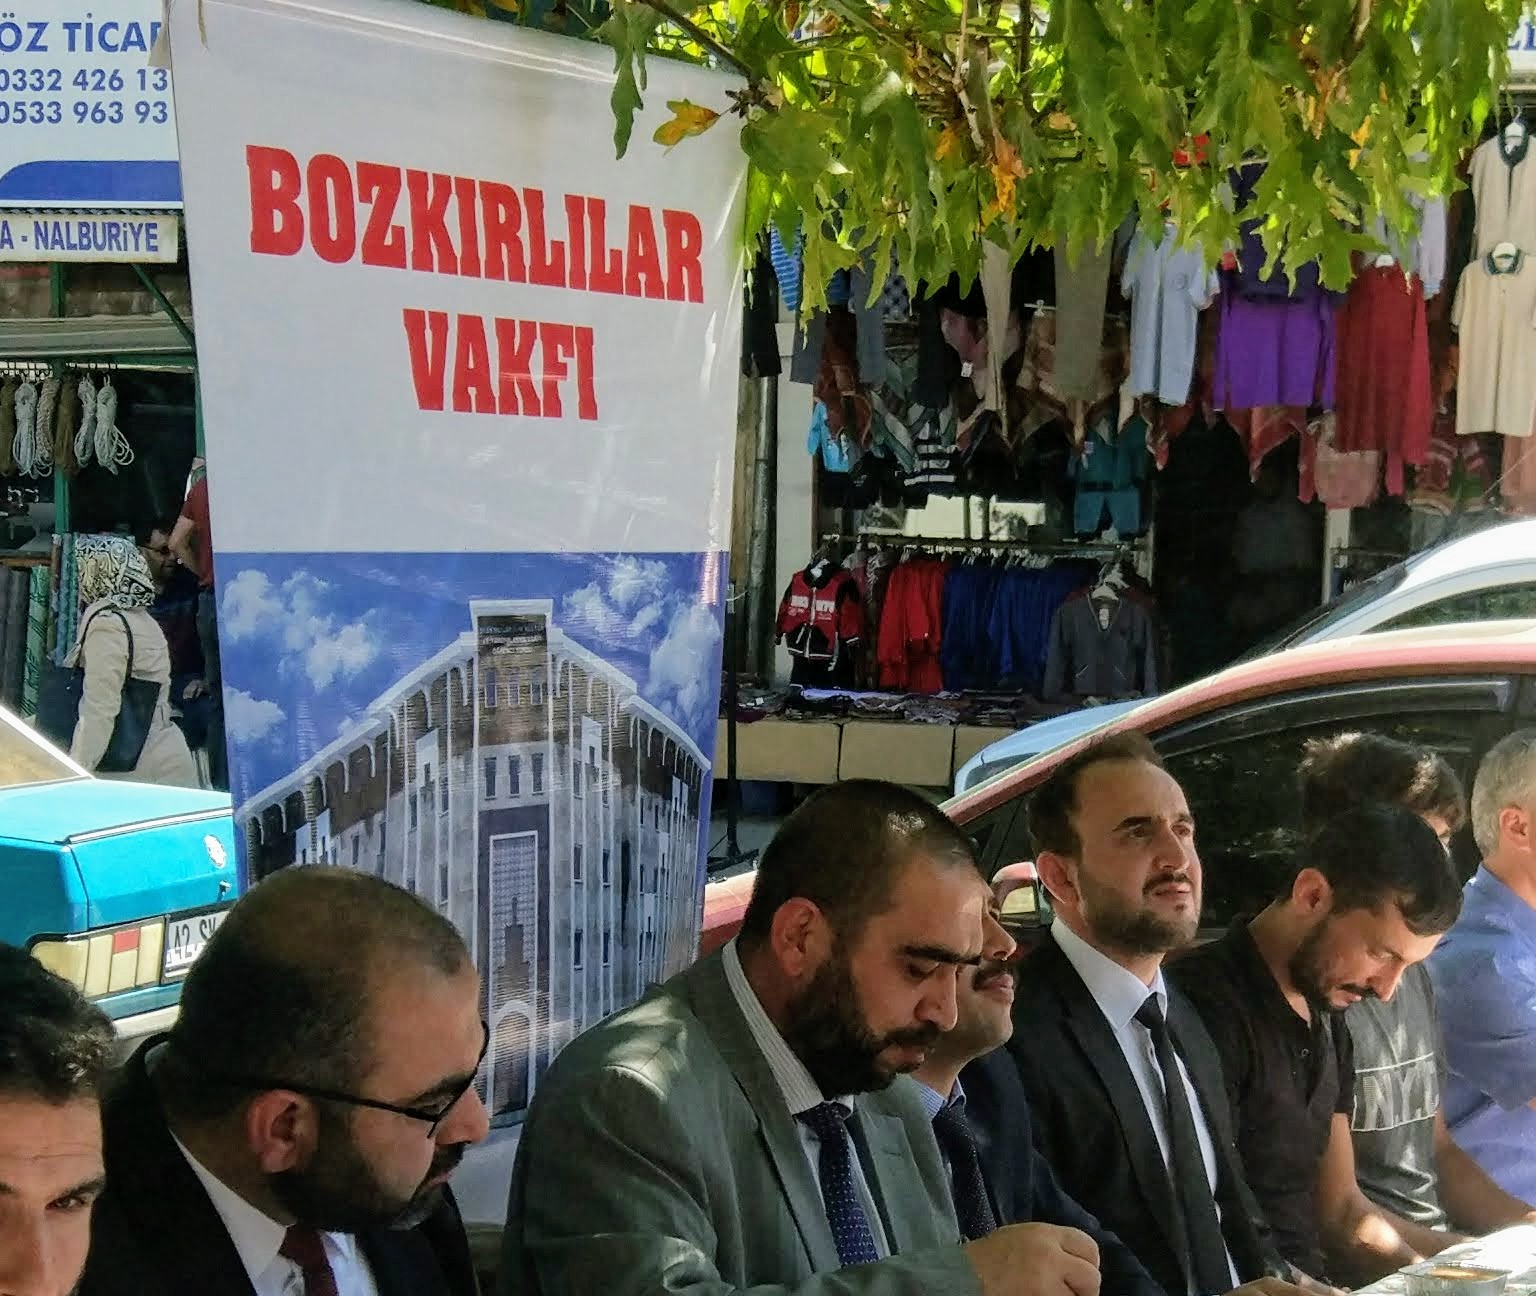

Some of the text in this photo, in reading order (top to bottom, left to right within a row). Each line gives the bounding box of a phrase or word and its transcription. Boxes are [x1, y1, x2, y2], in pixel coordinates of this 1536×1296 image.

[72, 68, 125, 92] 426
[136, 68, 168, 92] 13
[73, 100, 124, 125] 963
[134, 100, 168, 125] 93
[246, 144, 704, 304] BOZKIRLILAR
[402, 308, 599, 421] VAKFI
[174, 923, 192, 960] 42
